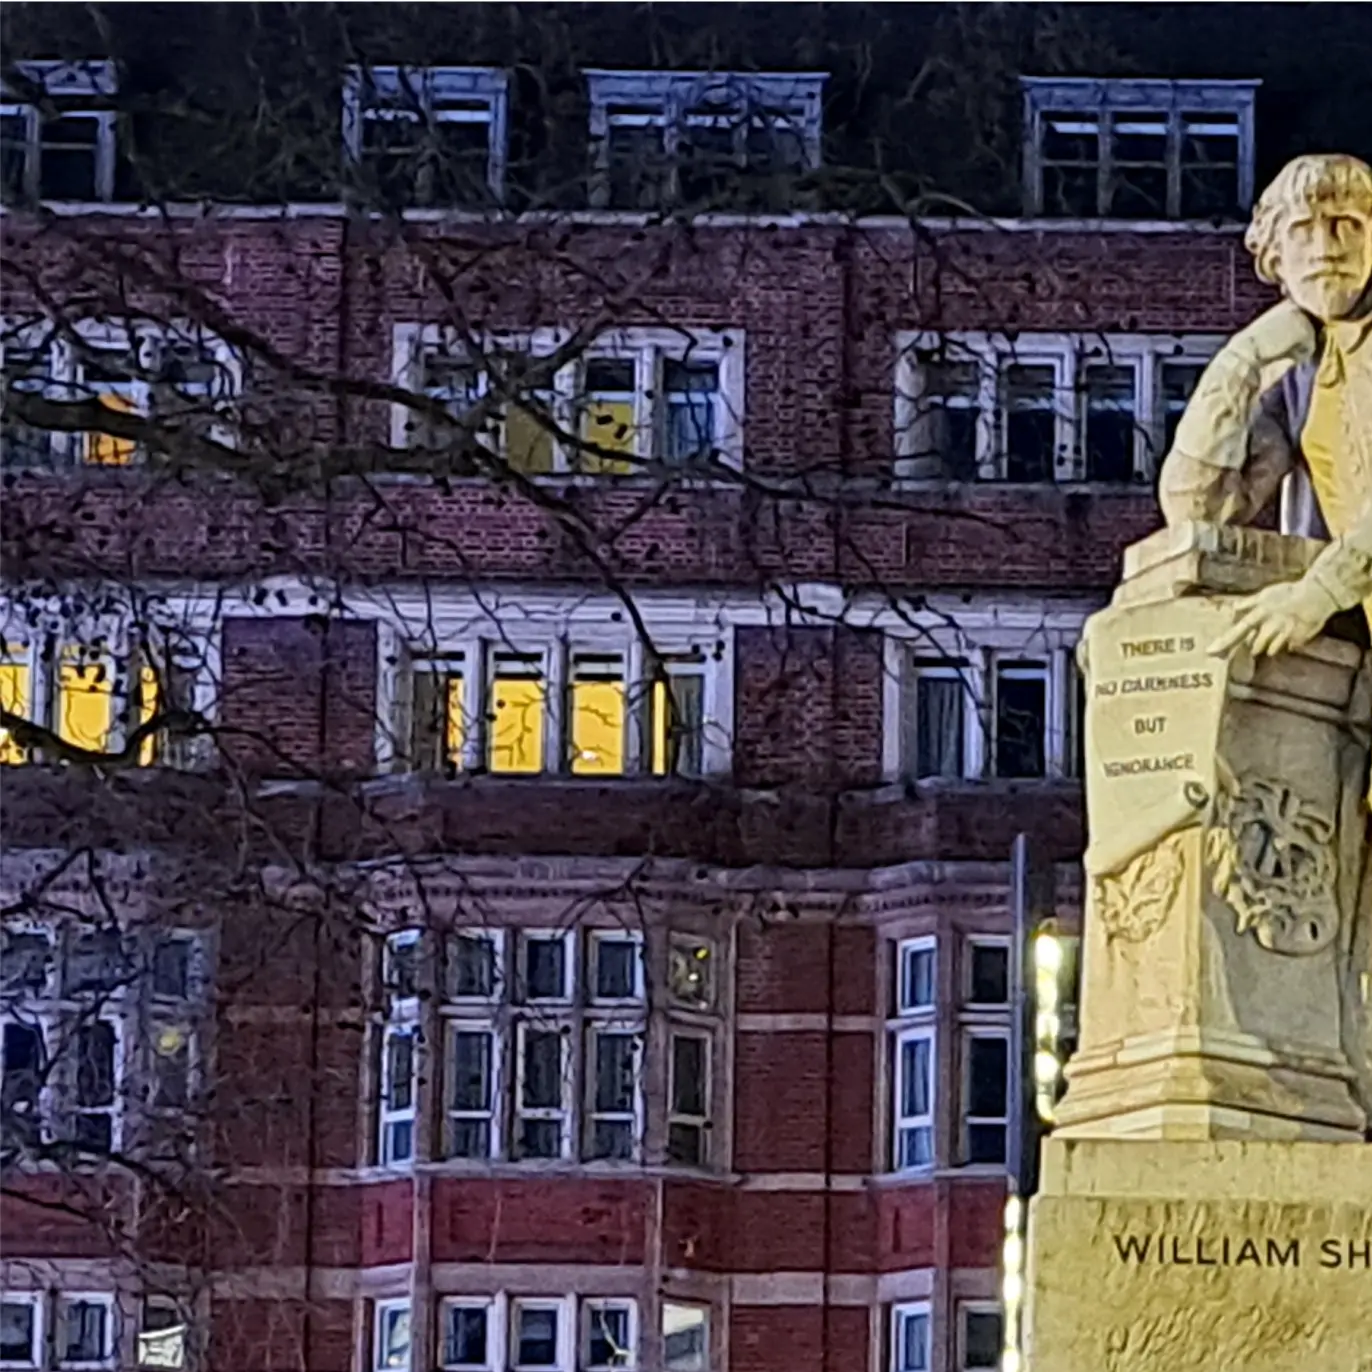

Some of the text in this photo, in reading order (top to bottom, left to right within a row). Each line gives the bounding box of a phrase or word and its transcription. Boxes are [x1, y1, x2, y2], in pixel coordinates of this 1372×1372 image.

[1121, 637, 1195, 658] THERE IS
[1134, 717, 1166, 734] BUT
[1104, 754, 1194, 777] IGNORANCE
[1114, 1236, 1301, 1268] WILLIAM
